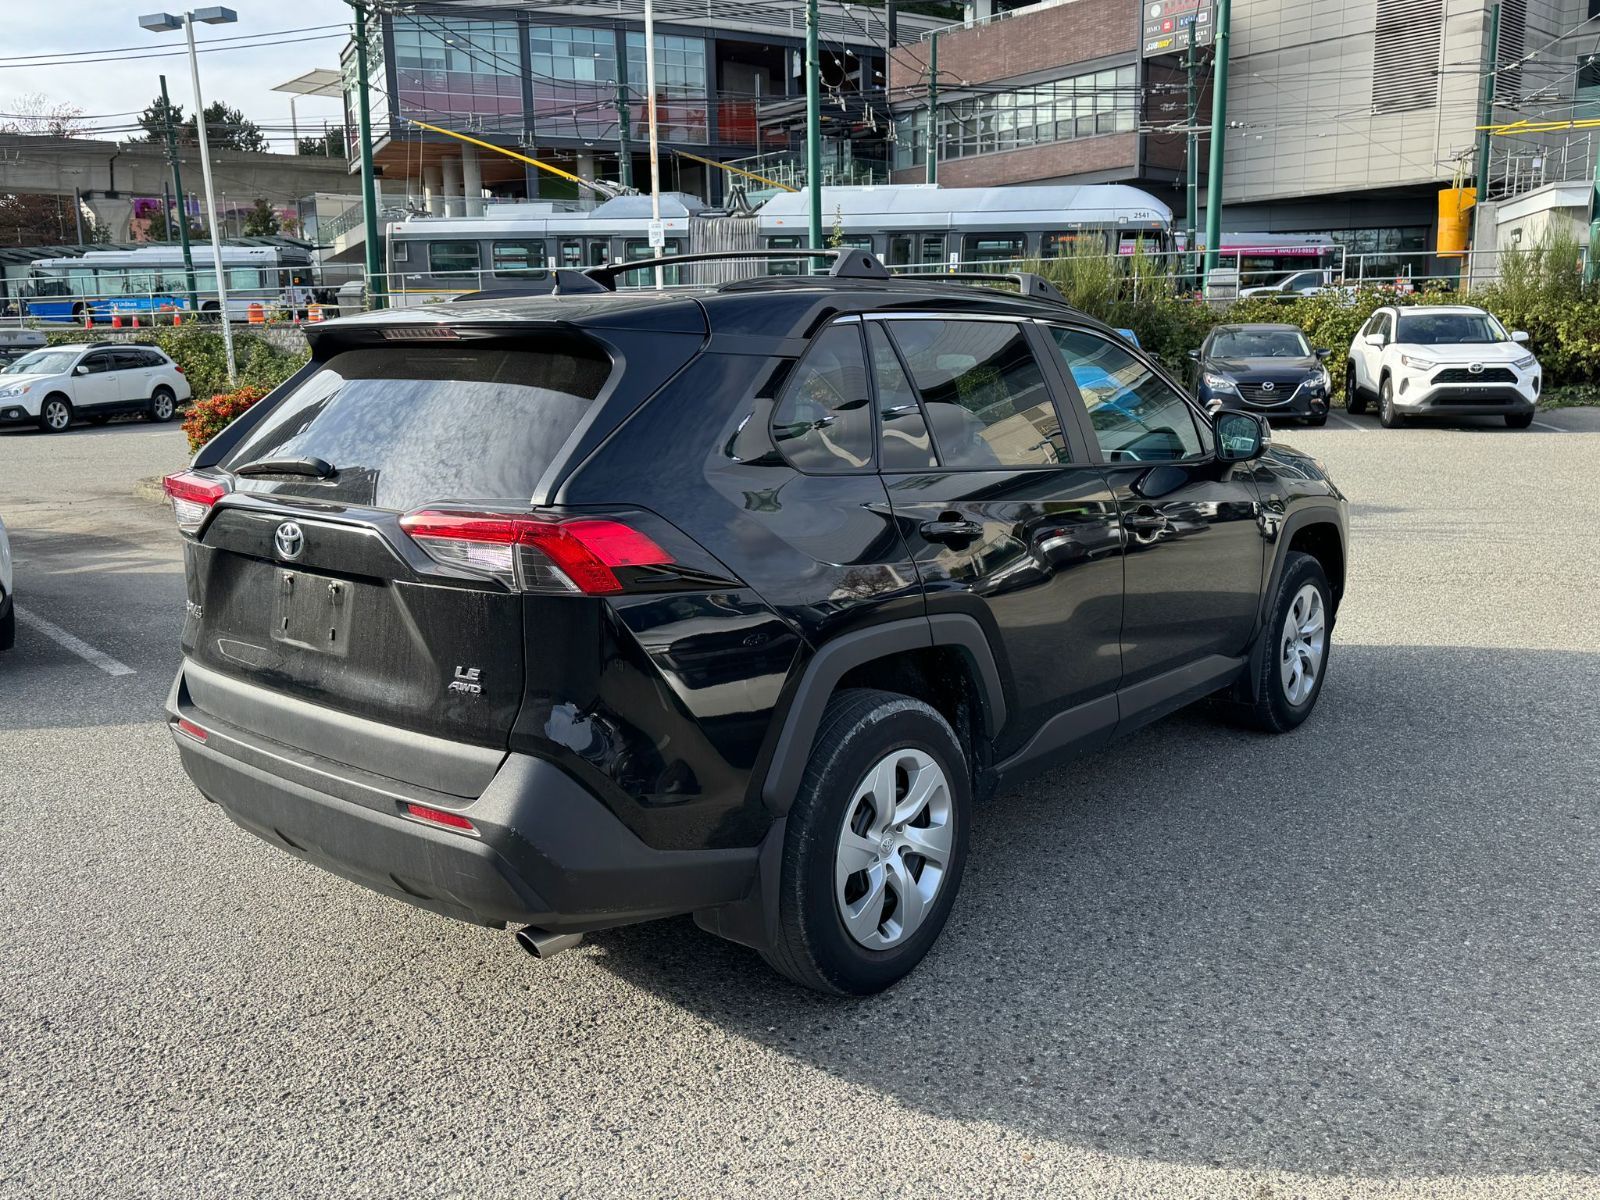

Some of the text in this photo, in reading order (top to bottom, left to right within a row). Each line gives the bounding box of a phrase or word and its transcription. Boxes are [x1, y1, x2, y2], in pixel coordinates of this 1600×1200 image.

[1146, 38, 1172, 51] SUBWAY
[455, 666, 480, 680] LE
[448, 681, 481, 693] AWD
